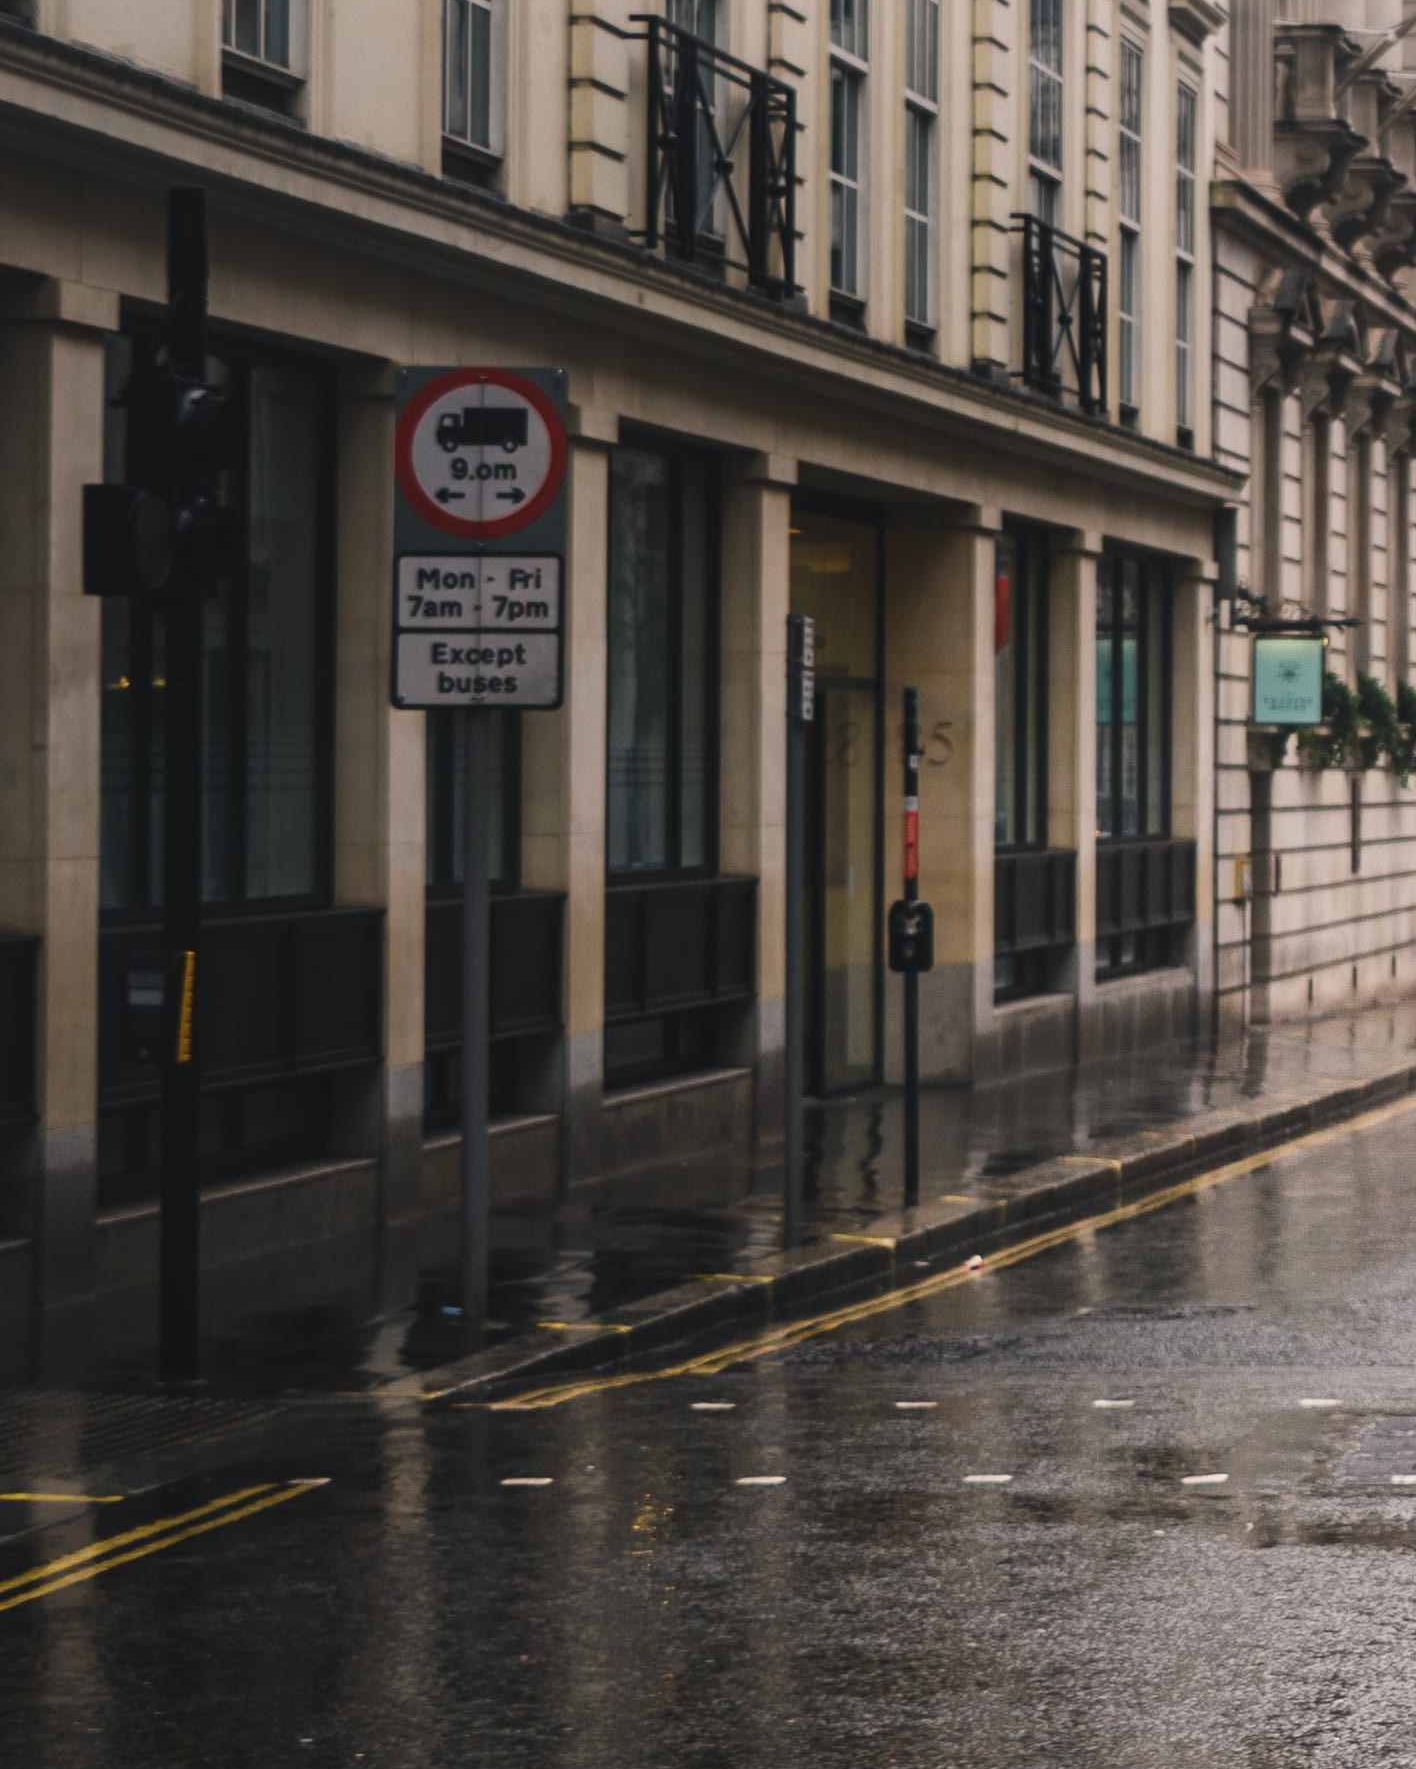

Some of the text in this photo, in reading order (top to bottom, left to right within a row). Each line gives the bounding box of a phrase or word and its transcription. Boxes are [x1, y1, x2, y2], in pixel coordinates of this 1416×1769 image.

[417, 568, 476, 591] Mon
[509, 568, 542, 590] Fri
[407, 595, 463, 618] 7am
[492, 595, 549, 622] 7pm
[431, 641, 527, 669] Except
[437, 670, 518, 694] buses
